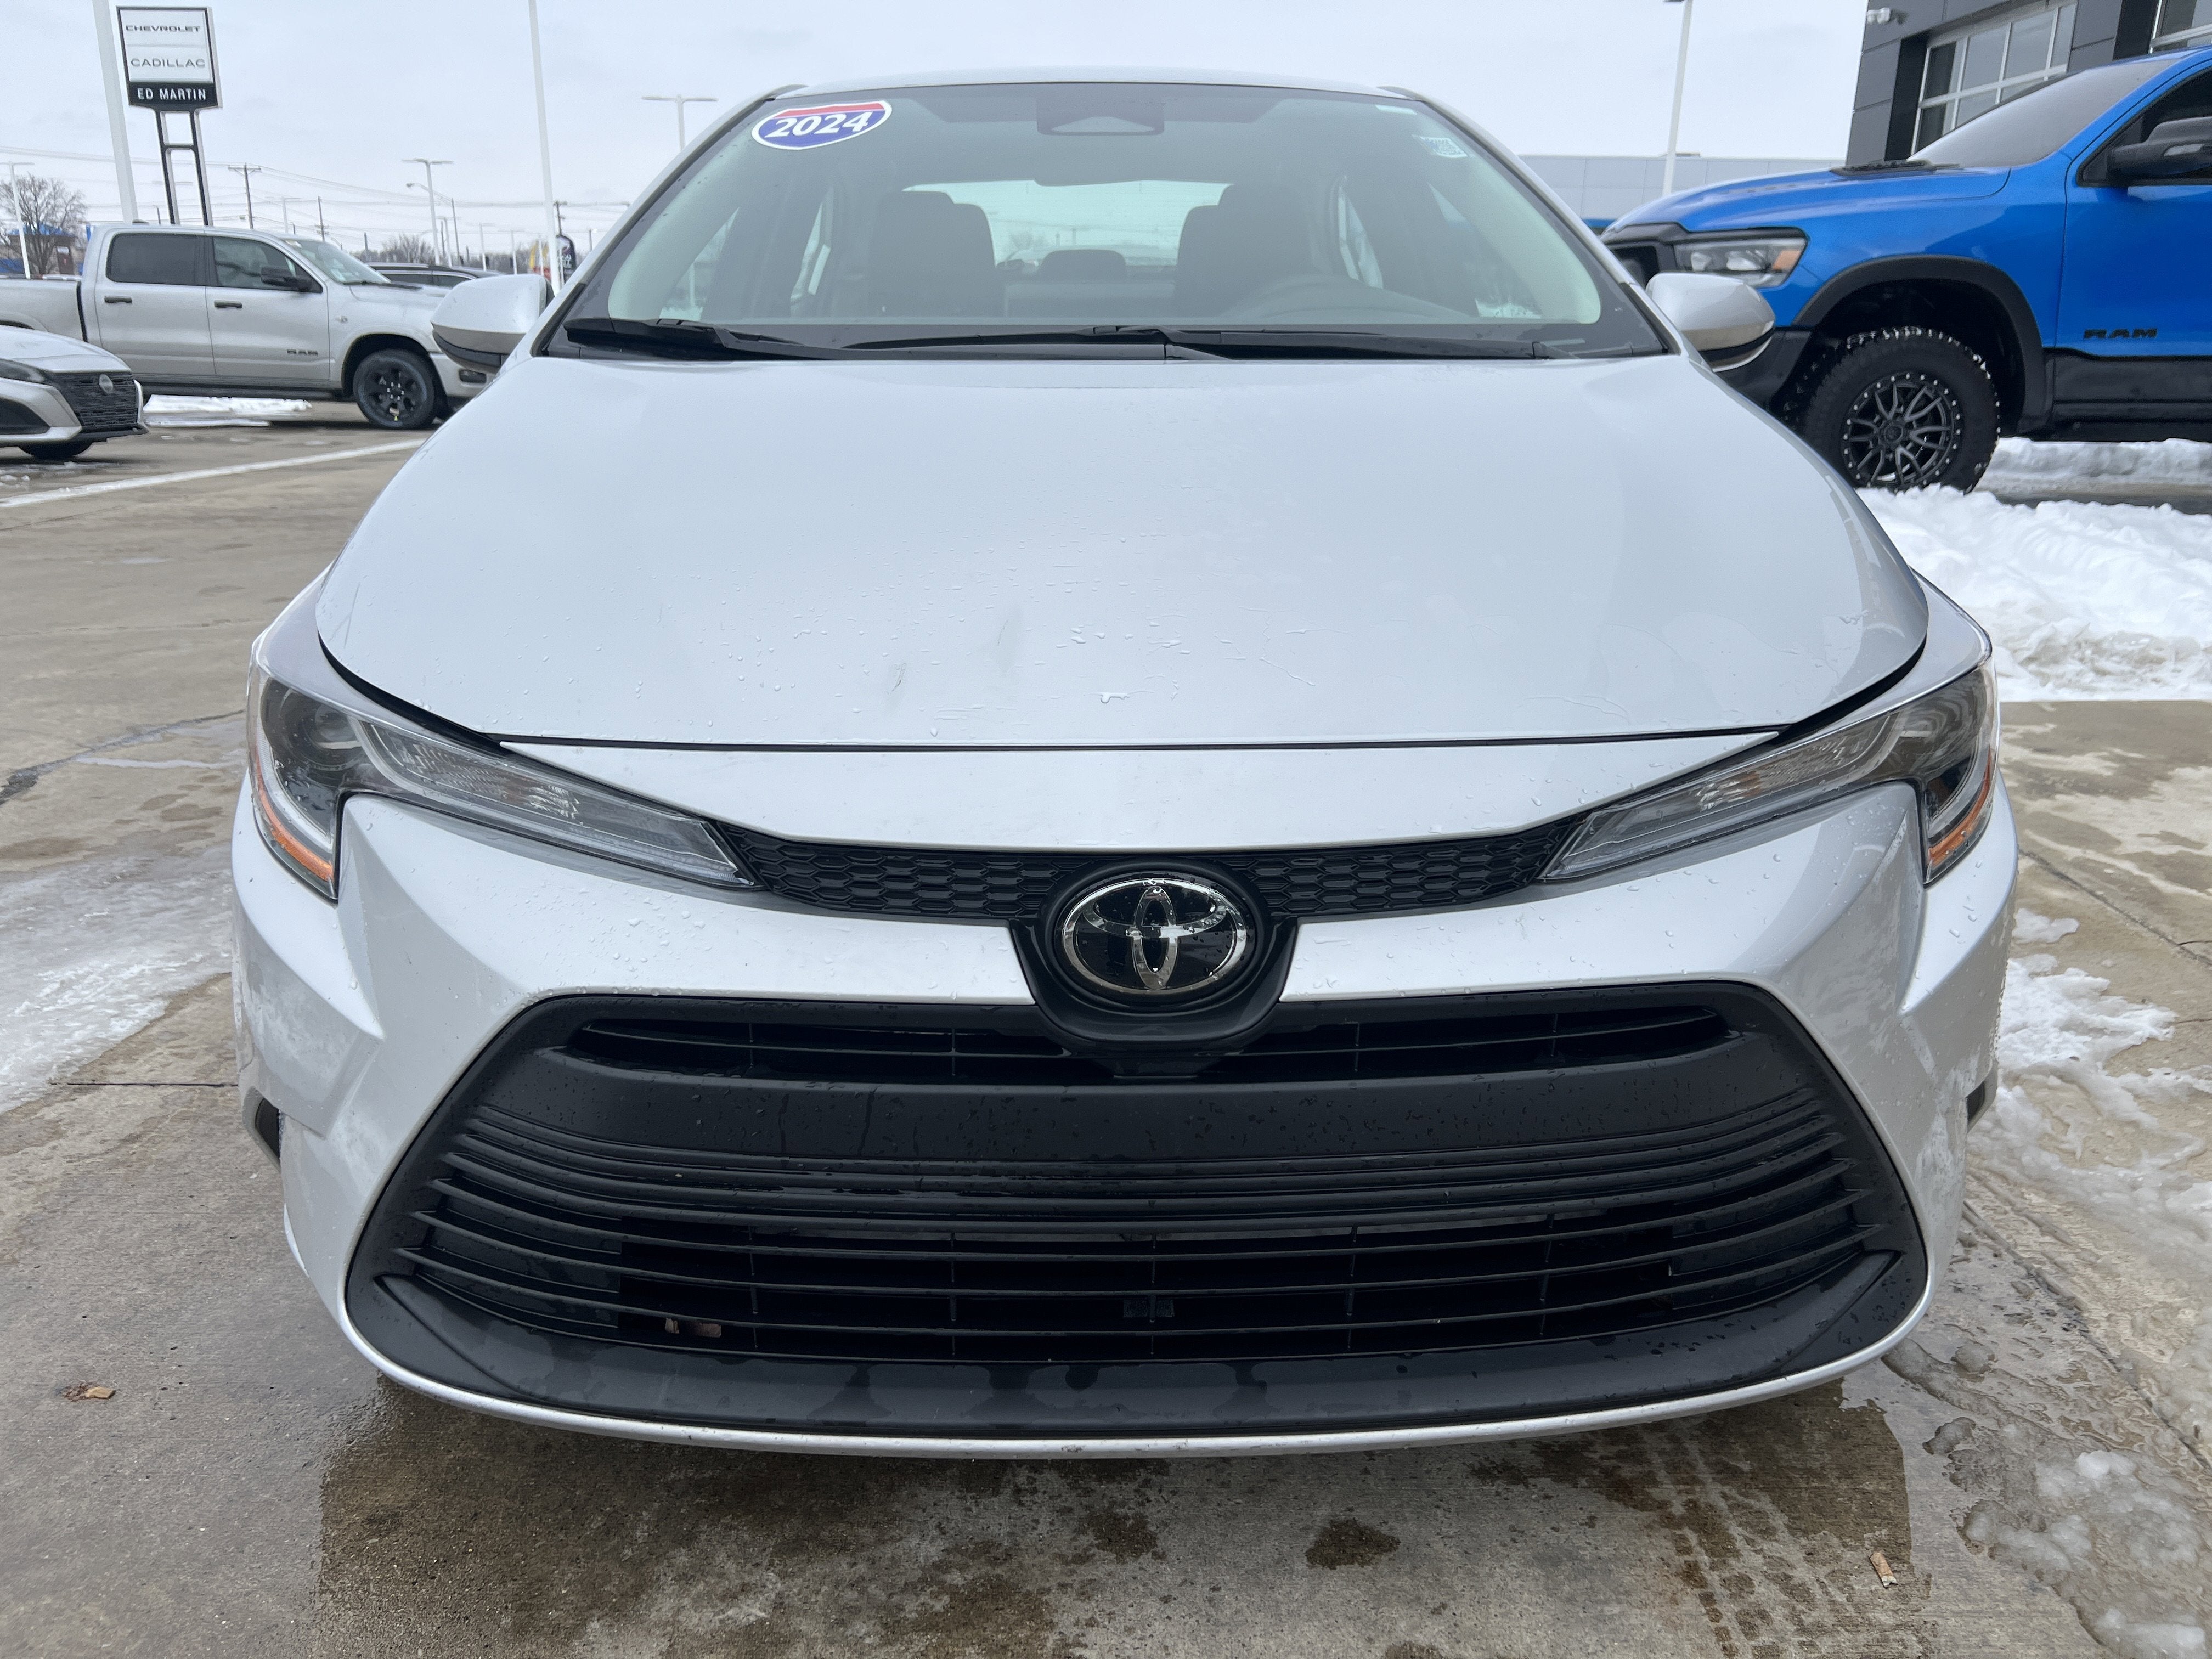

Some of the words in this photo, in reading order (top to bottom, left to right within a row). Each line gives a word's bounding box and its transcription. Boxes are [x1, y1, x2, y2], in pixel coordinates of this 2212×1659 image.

[131, 58, 205, 68] CADILLAC
[137, 88, 154, 100] ED
[159, 88, 206, 101] MARTIN
[764, 111, 873, 138] 2024
[2084, 328, 2157, 339] RAM
